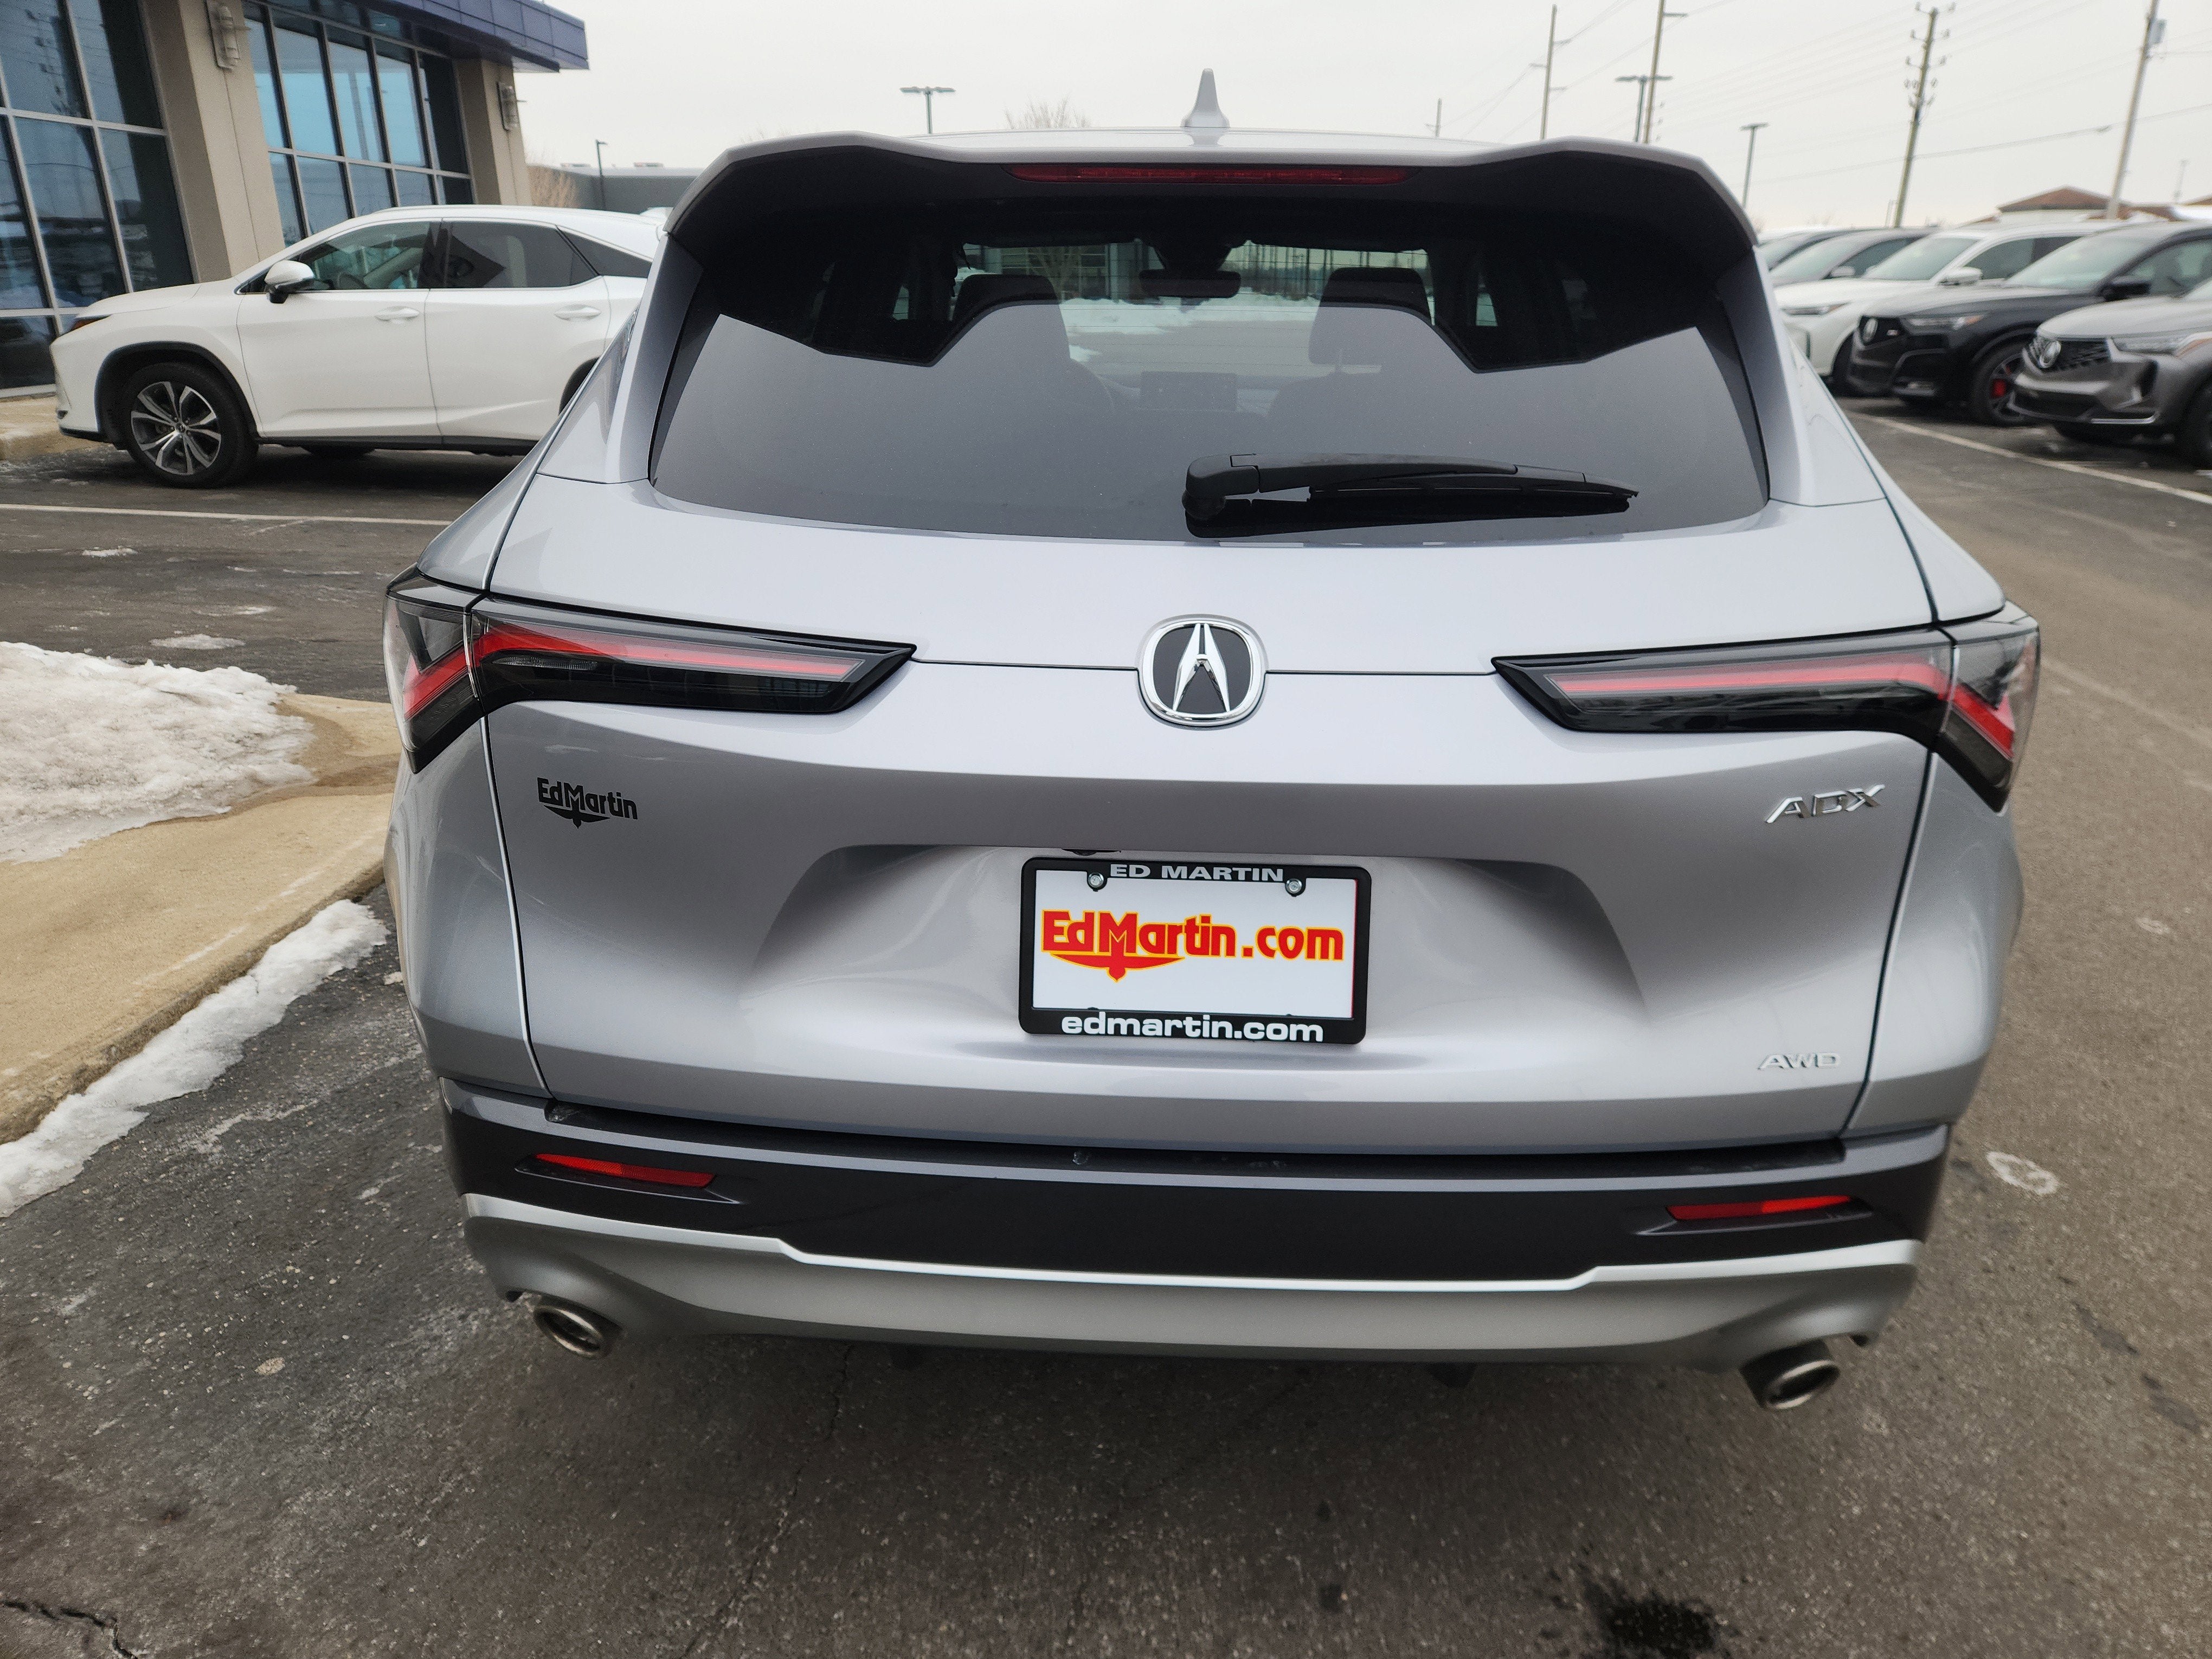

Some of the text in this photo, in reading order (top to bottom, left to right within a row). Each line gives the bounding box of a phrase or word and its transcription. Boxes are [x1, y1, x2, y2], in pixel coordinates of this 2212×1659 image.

[537, 777, 638, 820] EdMartin
[1763, 785, 1885, 824] ADX
[1110, 864, 1285, 882] ED MARTIN
[1061, 1012, 1324, 1043] edmartin.com
[1757, 1052, 1841, 1070] AWD
